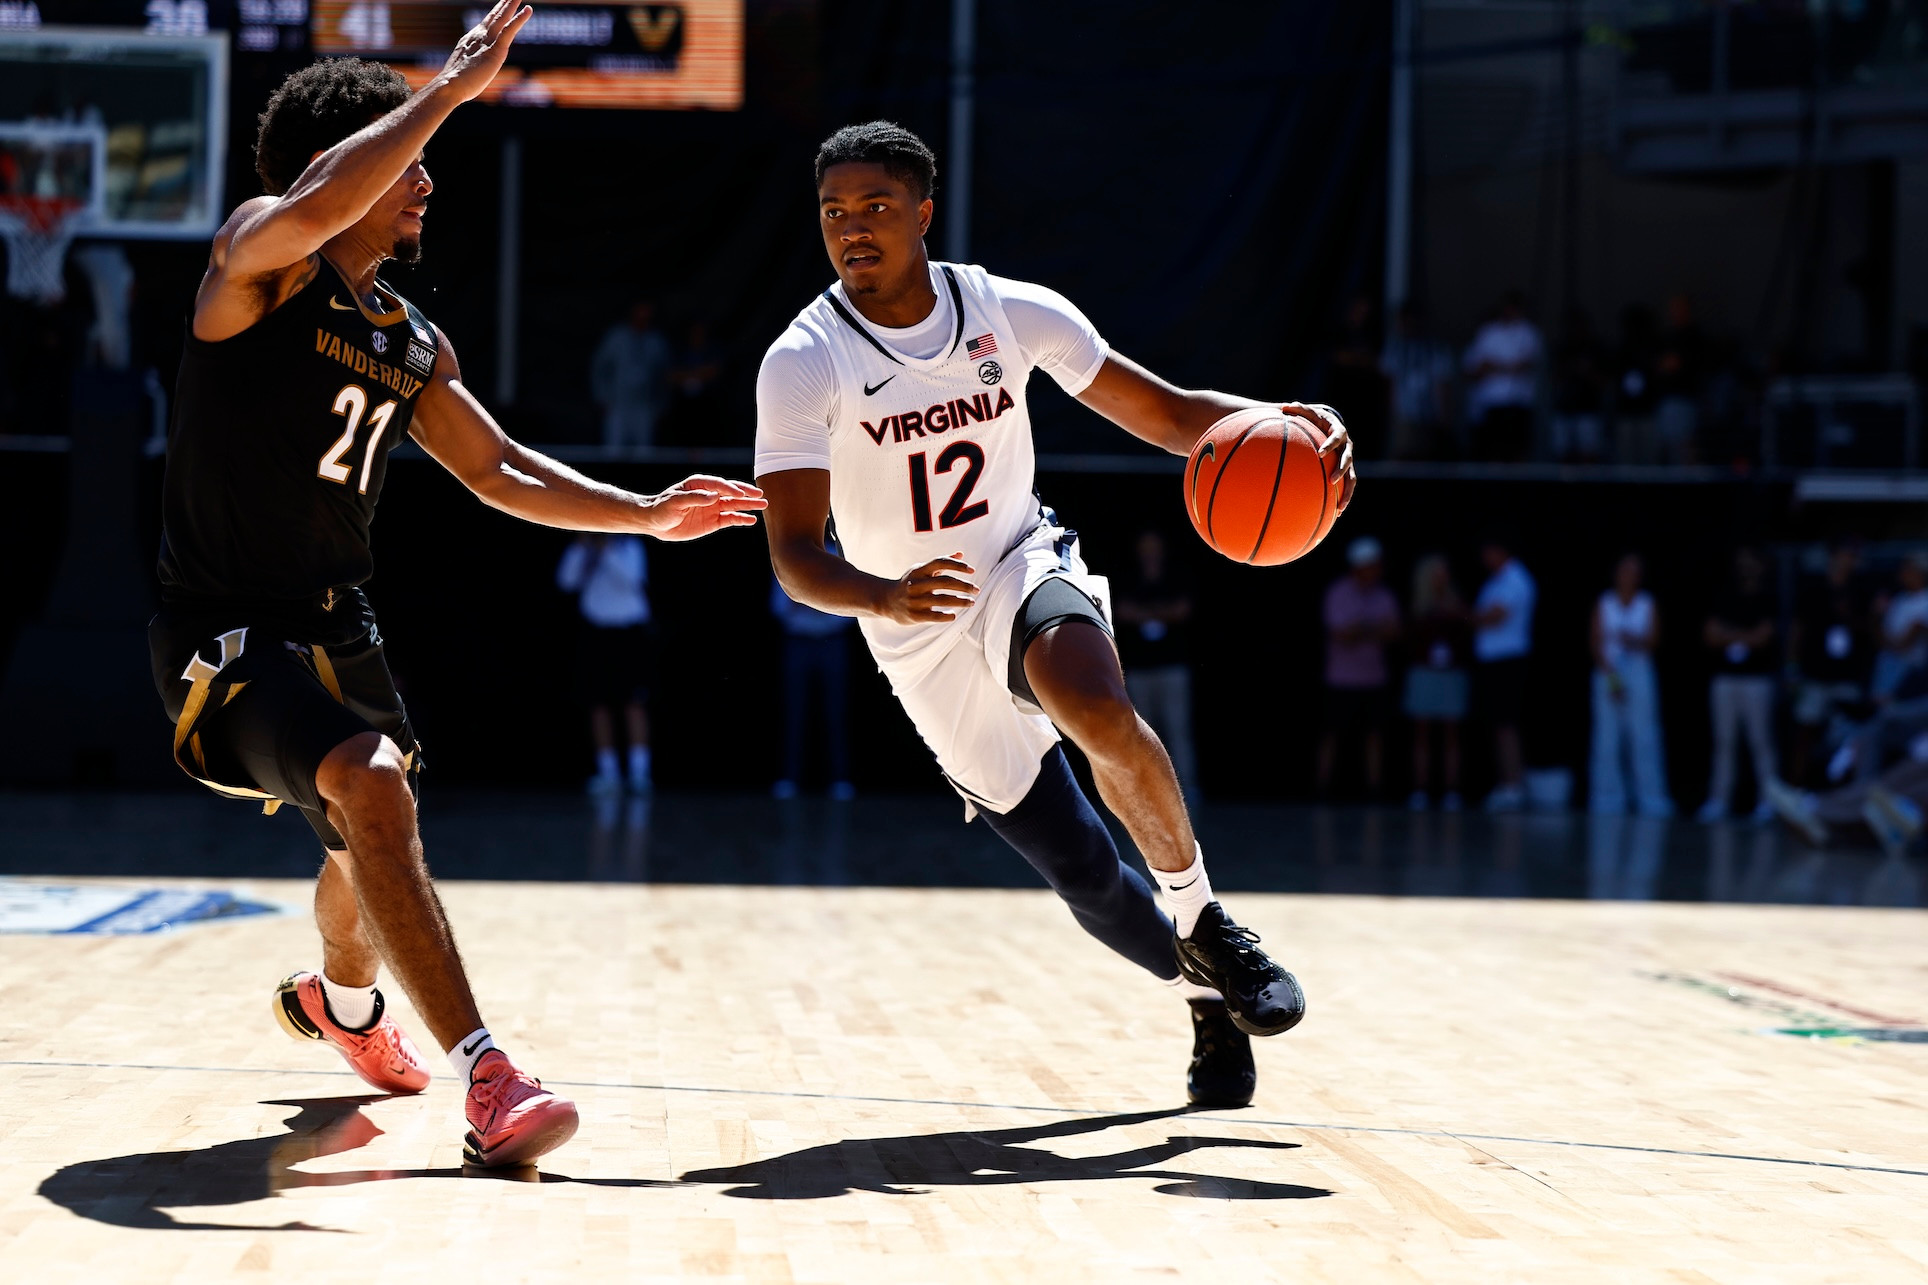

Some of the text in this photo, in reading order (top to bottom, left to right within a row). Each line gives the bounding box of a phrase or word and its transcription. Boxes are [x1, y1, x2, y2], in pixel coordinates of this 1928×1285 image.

[338, 4, 394, 50] 41
[372, 330, 388, 353] SEC
[414, 345, 434, 367] SRM
[317, 384, 398, 496] 21
[860, 387, 1015, 446] VIRGINIA
[908, 440, 989, 532] 12
